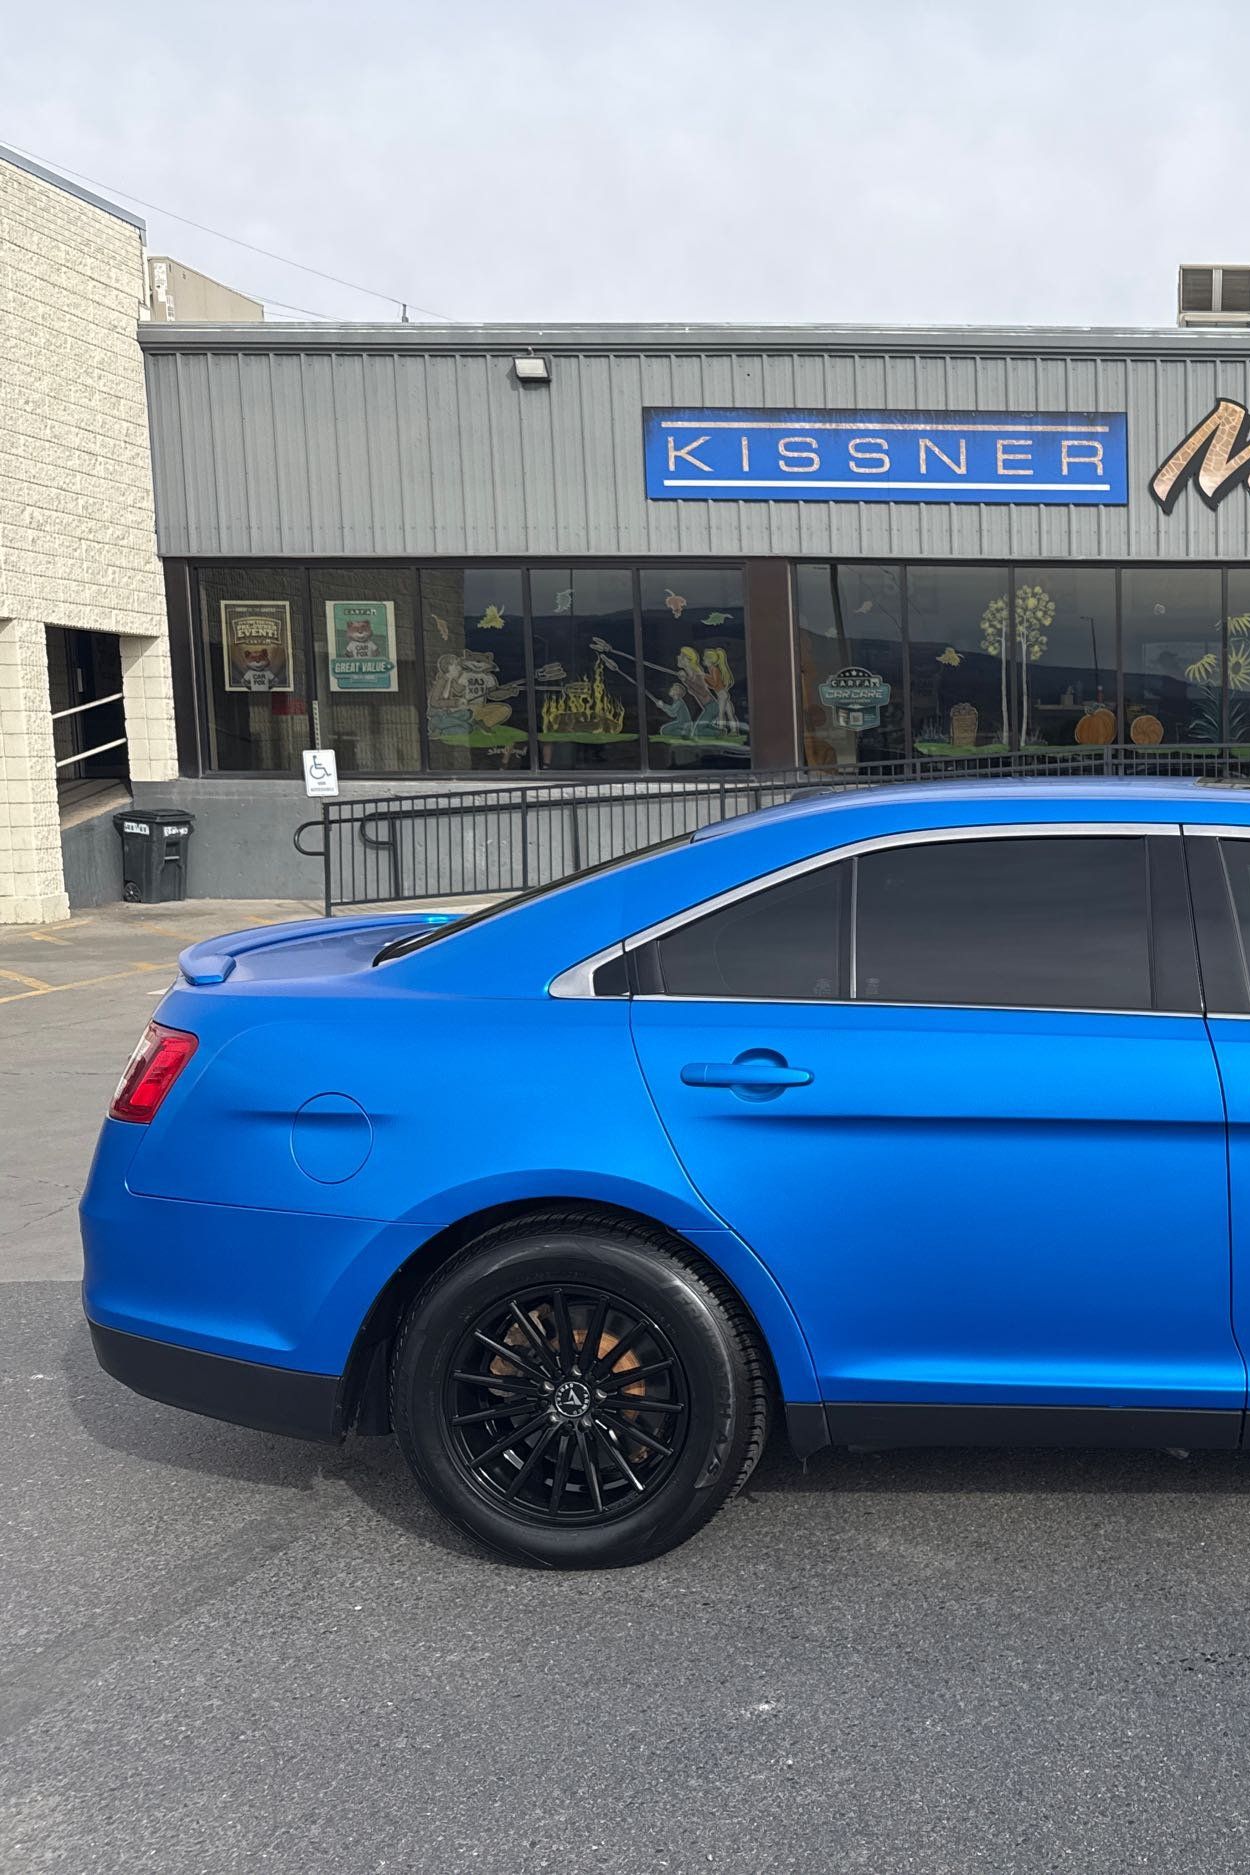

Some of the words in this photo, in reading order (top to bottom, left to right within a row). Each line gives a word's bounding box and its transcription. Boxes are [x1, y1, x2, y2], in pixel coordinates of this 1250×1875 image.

[665, 435, 1106, 476] KISSNER
[237, 629, 278, 638] EVENT!
[335, 662, 359, 673] GREAT
[362, 662, 386, 672] VALUE
[831, 679, 880, 688] CARFAX
[826, 690, 849, 698] CAR
[851, 690, 883, 698] CARE
